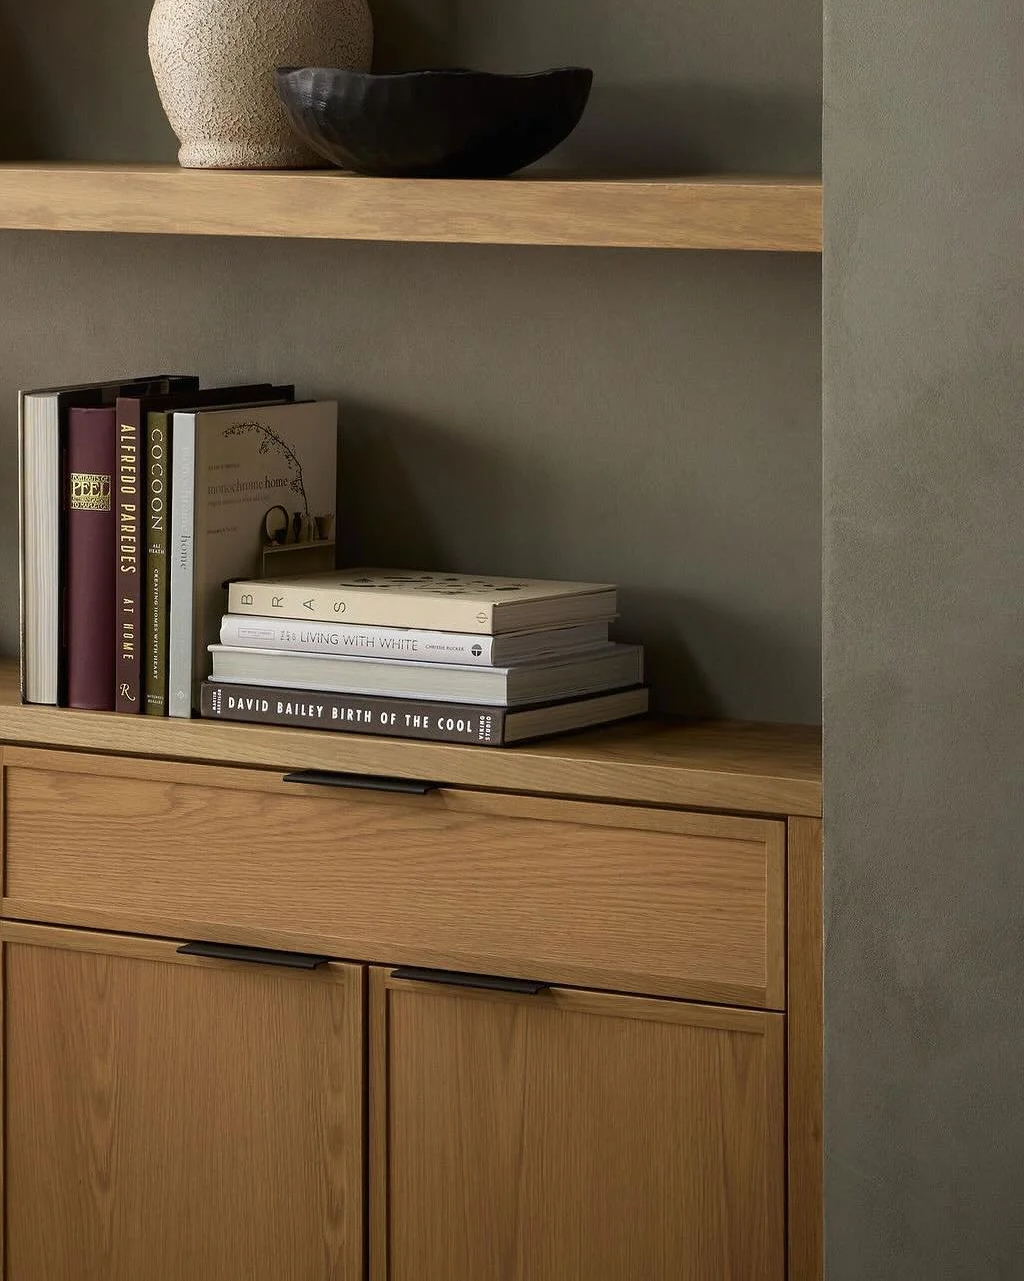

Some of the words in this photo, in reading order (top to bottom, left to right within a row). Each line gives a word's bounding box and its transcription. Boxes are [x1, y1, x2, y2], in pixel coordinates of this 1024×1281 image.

[120, 424, 136, 495] ALFREDO
[73, 481, 110, 497] PEEL
[151, 428, 163, 531] COCOON
[265, 475, 288, 488] home
[120, 503, 136, 575] PAREDES
[180, 534, 191, 571] home
[123, 598, 134, 614] AT
[123, 623, 134, 661] HOME
[300, 631, 339, 645] LIVING
[342, 634, 375, 648] WITH
[379, 637, 418, 651] WHITE
[228, 696, 269, 712] DAVID
[277, 701, 323, 718] BAILEY
[331, 707, 372, 723] BIRTH
[380, 712, 397, 725] OF
[405, 714, 429, 728] THE
[437, 718, 473, 733] COOL
